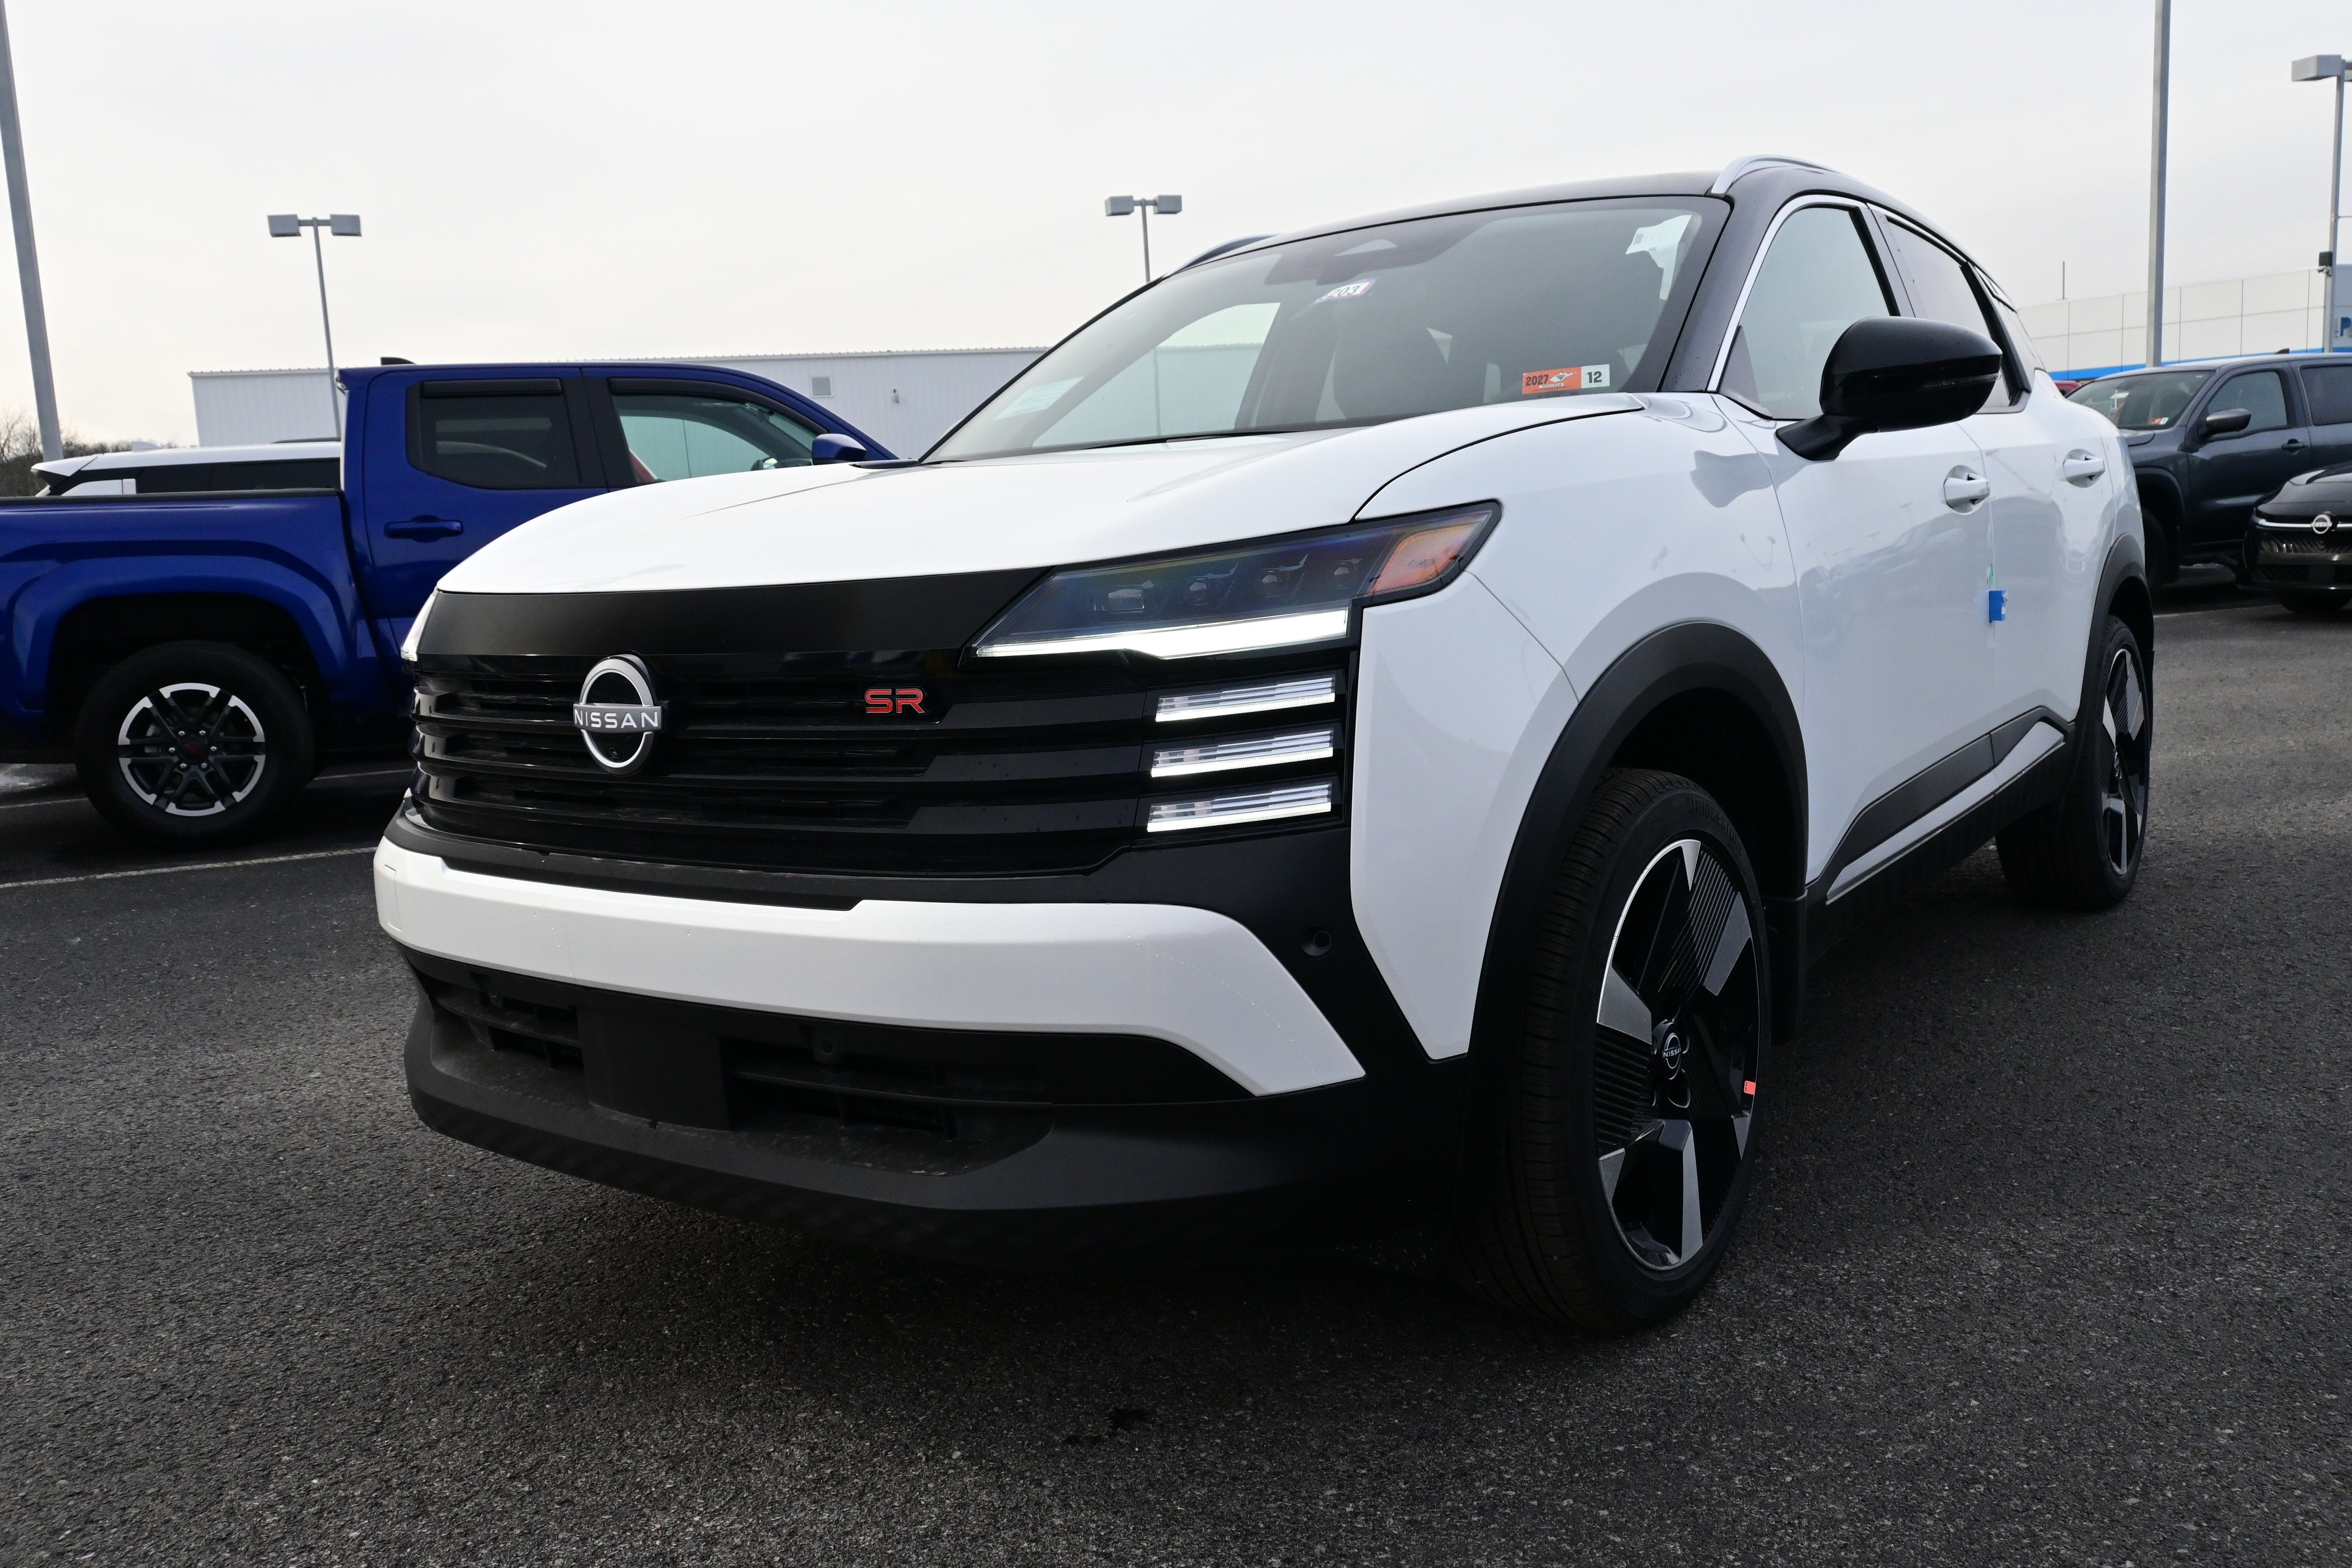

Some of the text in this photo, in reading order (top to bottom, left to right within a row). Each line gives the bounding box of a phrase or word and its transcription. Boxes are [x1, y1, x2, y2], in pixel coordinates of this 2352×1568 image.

[1526, 371, 1602, 386] 2027 12
[865, 689, 925, 713] SR
[574, 709, 658, 728] NISSAN
